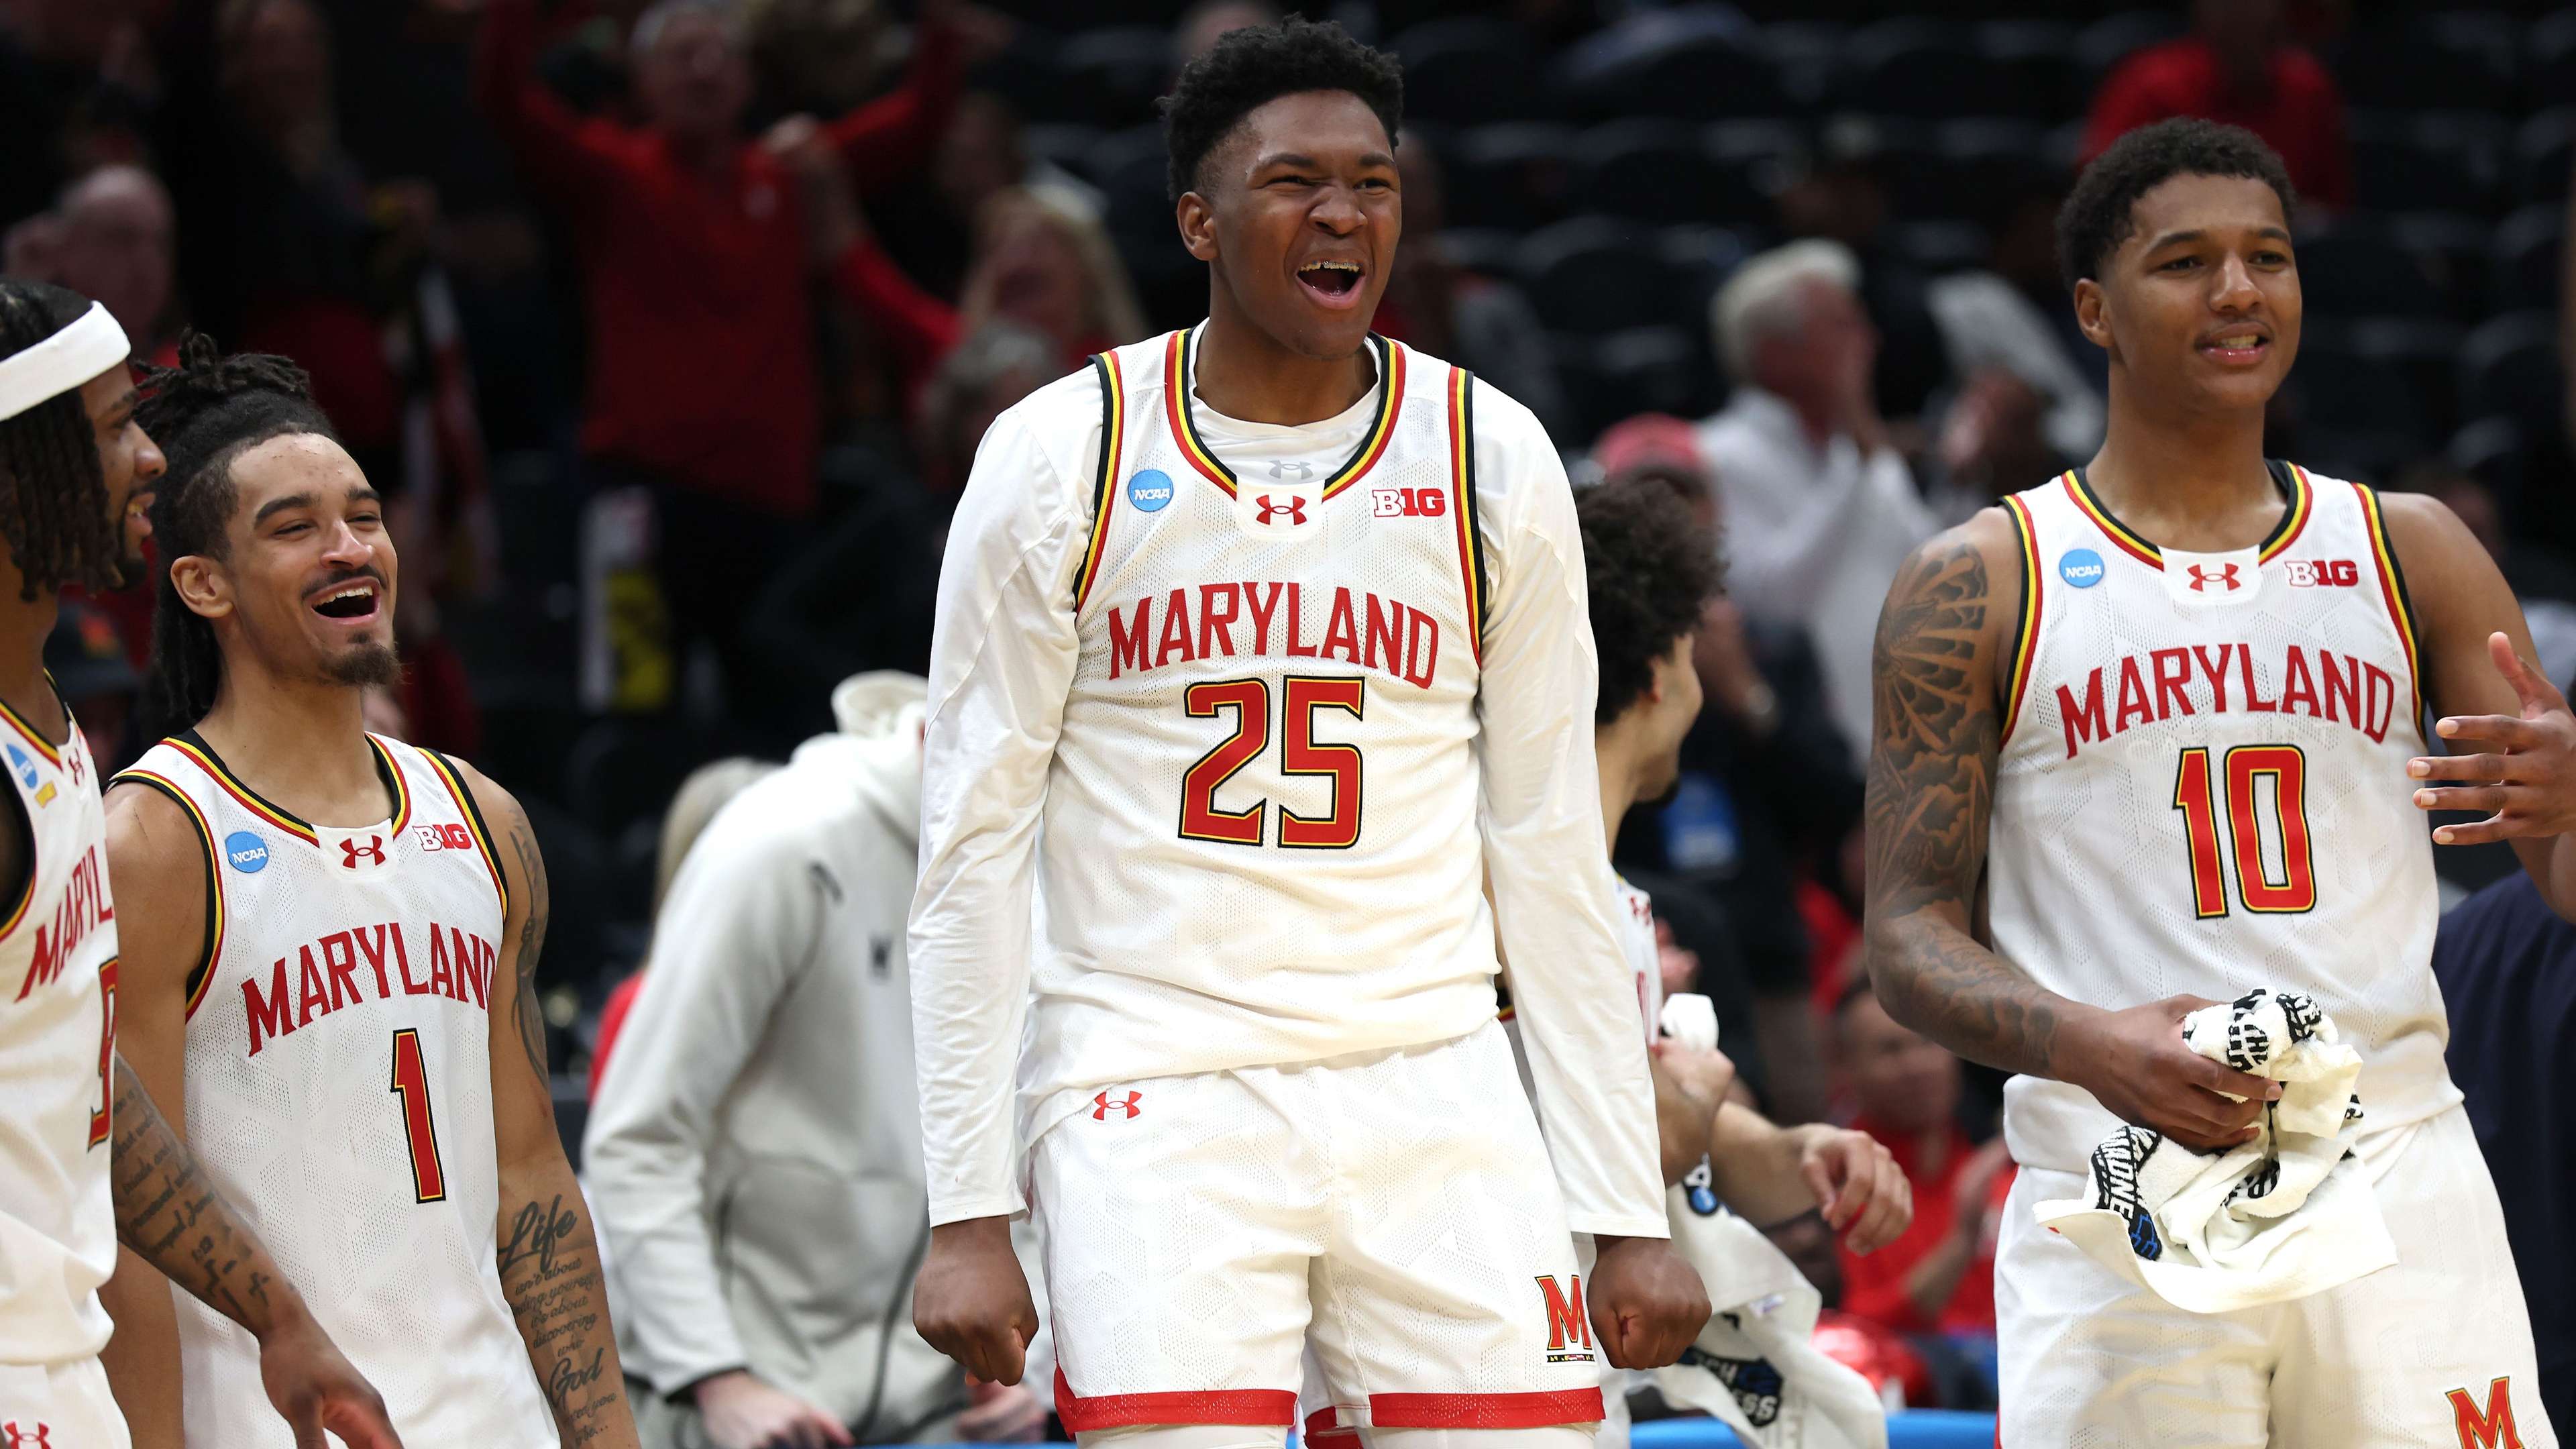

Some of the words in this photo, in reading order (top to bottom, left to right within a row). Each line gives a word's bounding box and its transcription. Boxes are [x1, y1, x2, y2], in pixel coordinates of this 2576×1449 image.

[1134, 488, 1171, 500] NCAA
[2065, 565, 2102, 578] NCAA
[1108, 582, 1438, 690] MARYLAND
[2055, 643, 2394, 759] MARYLAND
[1178, 676, 1365, 849] 25
[231, 847, 267, 863] NCAA
[2172, 744, 2316, 920] 10
[240, 922, 496, 1057] MARYLAND
[390, 1028, 445, 1204] 1
[497, 1193, 577, 1274] Life
[545, 1256, 582, 1281] about
[533, 1311, 598, 1349] discovering
[549, 1294, 588, 1318] about
[1535, 1275, 1592, 1350] M
[549, 1347, 604, 1411] God
[2445, 1376, 2526, 1449] M
